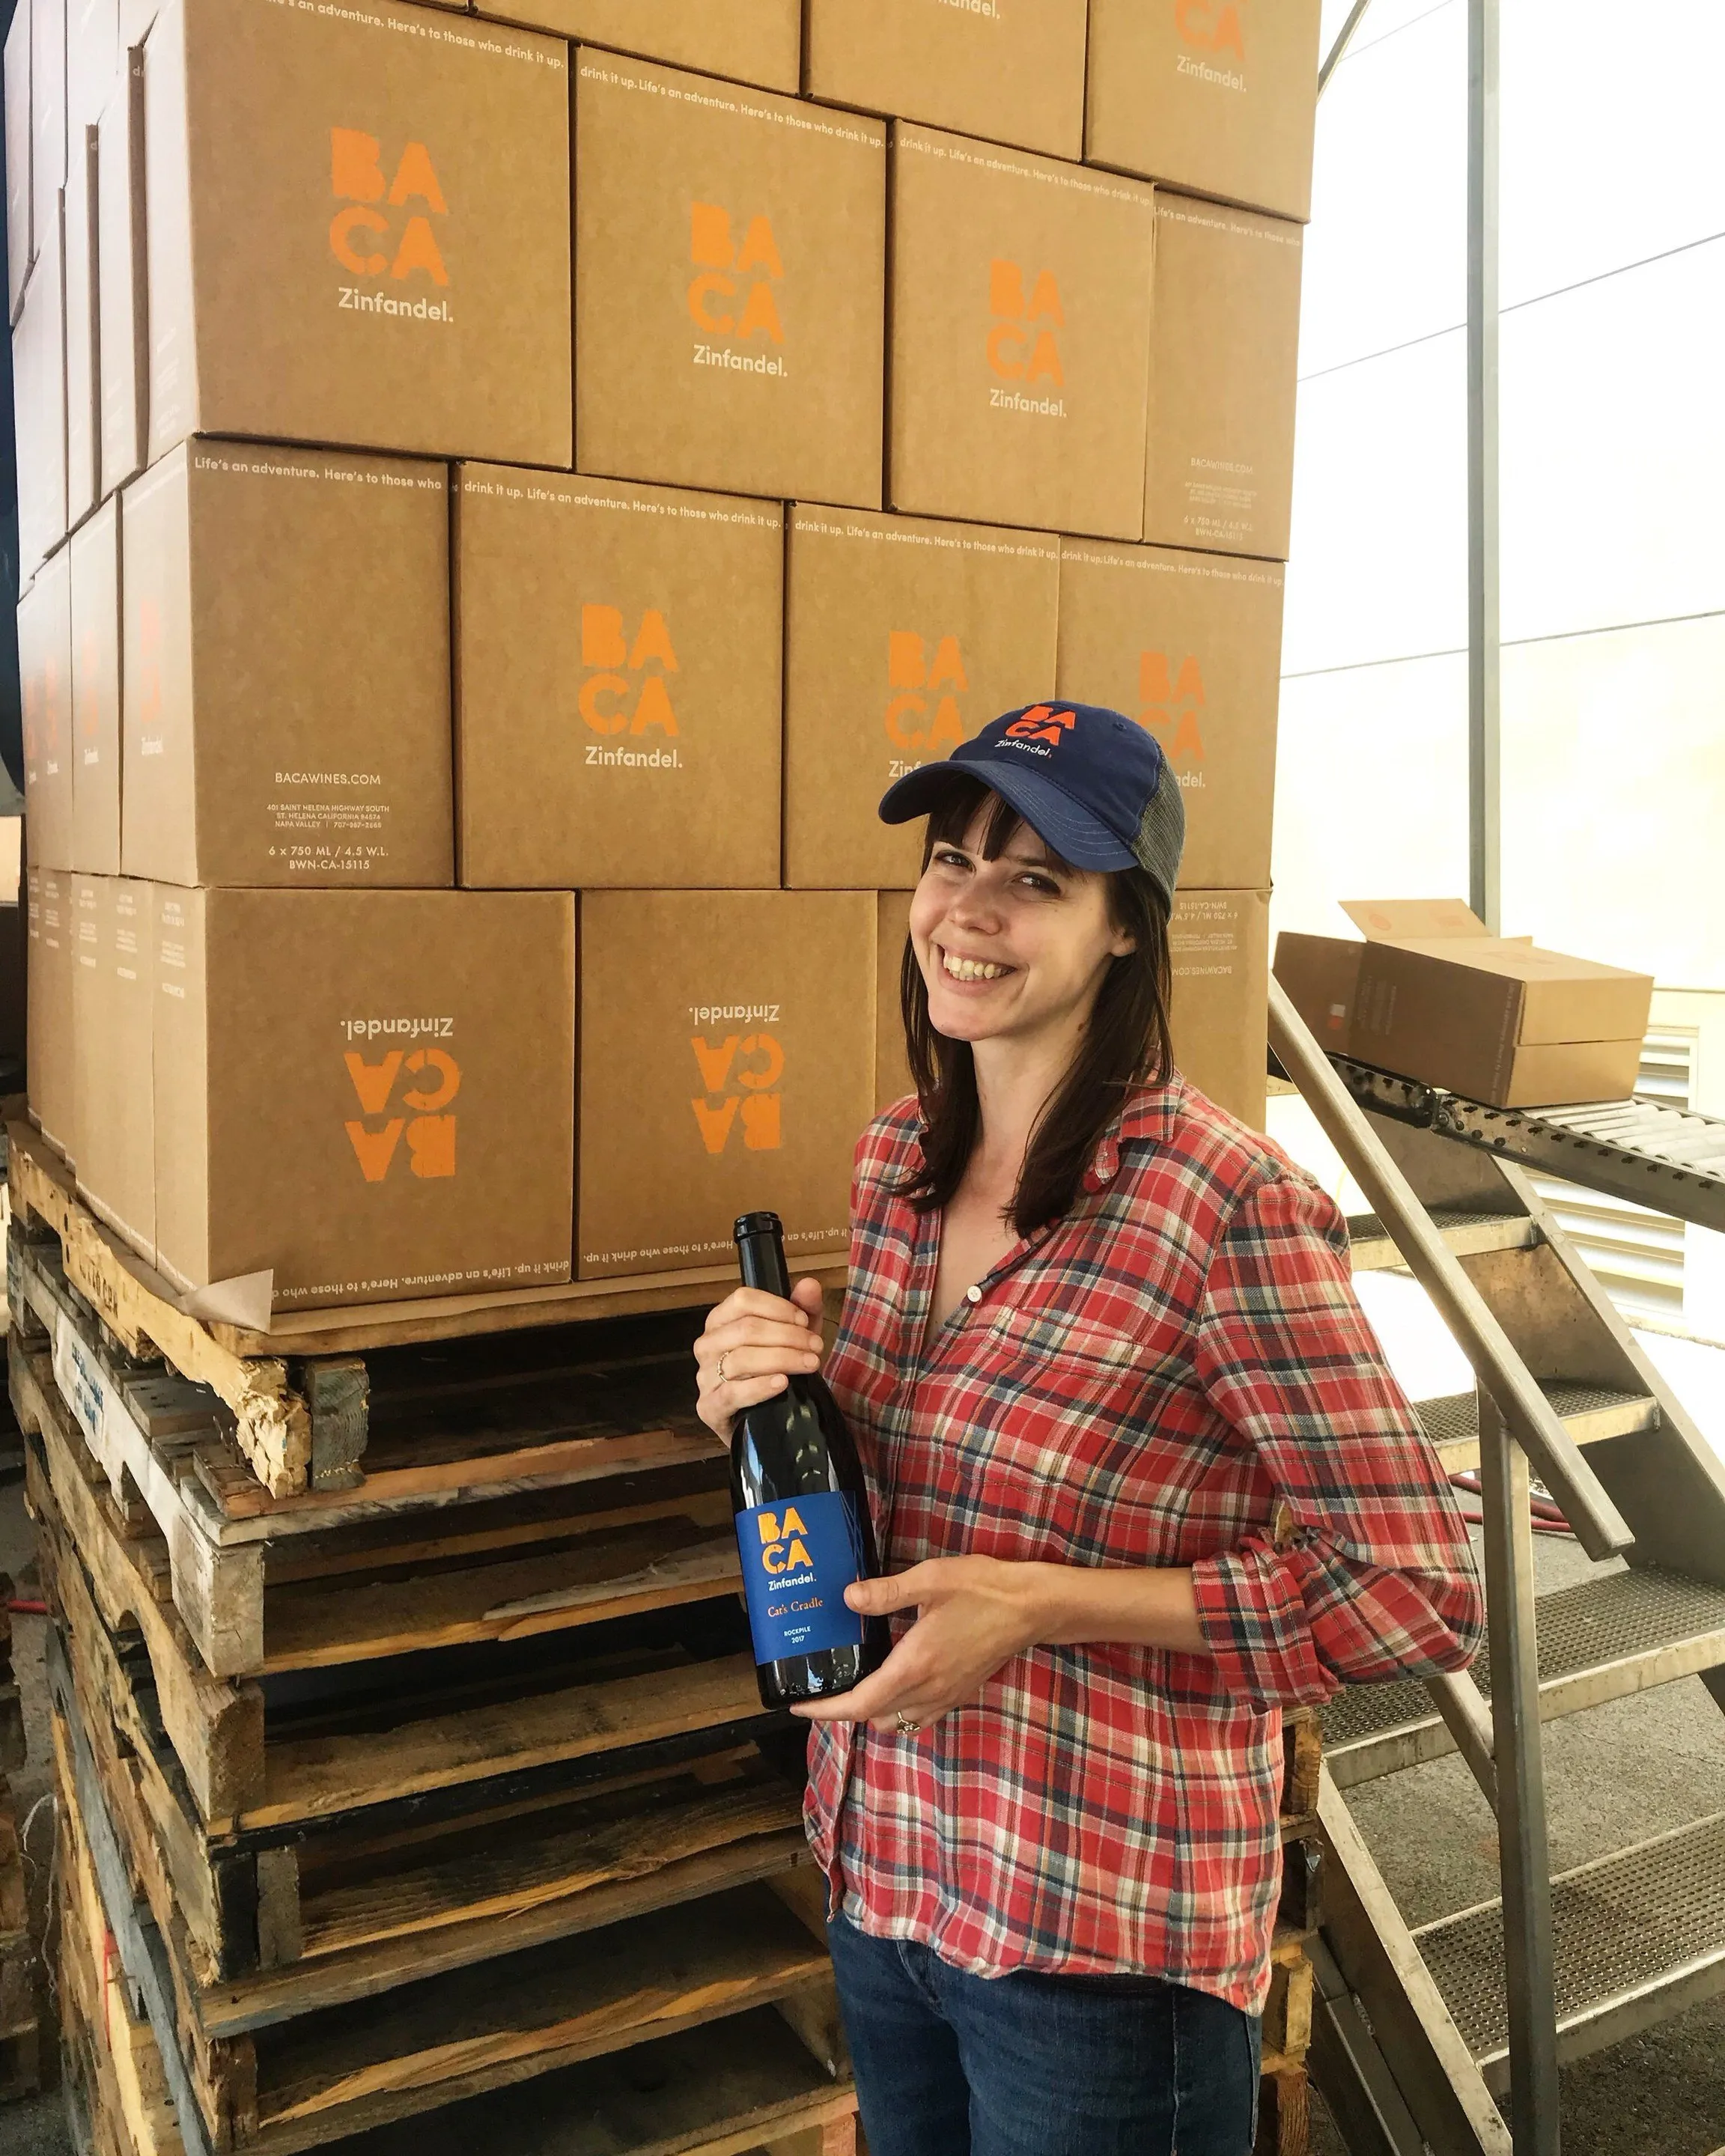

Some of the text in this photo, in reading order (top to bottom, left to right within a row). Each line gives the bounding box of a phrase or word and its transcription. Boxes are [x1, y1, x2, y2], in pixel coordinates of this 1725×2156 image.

[297, 0, 314, 12] an
[317, 3, 384, 27] adventure.
[387, 17, 426, 37] Here's
[428, 27, 441, 40] to
[442, 30, 475, 47] those
[478, 39, 502, 53] who
[505, 44, 534, 61] drink
[536, 50, 544, 63] it
[546, 56, 564, 70] up.
[1176, 54, 1247, 93] Zinfandel.
[579, 65, 884, 148] drink it up. Life's an adventure. Here's to those who drink it up.
[331, 127, 448, 215] BA
[899, 136, 1110, 196] drink it up. Life's an adventure. Here's to those who
[329, 205, 449, 287] CA
[690, 201, 785, 279] BA
[338, 287, 454, 323] Zinfandel.
[989, 258, 1065, 329] BA
[687, 272, 785, 344] CA
[693, 344, 788, 378] Zinfandel.
[987, 323, 1065, 387] CA
[989, 388, 1068, 418] Zinfandel.
[195, 456, 442, 490] Life's an adventure. Here's to those who
[464, 480, 781, 530] drink it up. Life's an adventure. Here's to those who drink it up.
[794, 519, 1058, 561] drink it up. Life's an adventure. Here's to those who drink it up.
[582, 604, 679, 672] BA
[889, 630, 969, 692] BA
[1140, 651, 1205, 706] BA
[579, 673, 679, 737] CA
[1020, 704, 1076, 731] BA
[884, 692, 966, 750] CA
[1005, 720, 1061, 746] CA
[585, 745, 683, 770] Zinfandel.
[994, 739, 1052, 759] Zinfandel.
[275, 772, 381, 785] BACAWINES.COM
[280, 803, 301, 811] SAINT
[302, 804, 329, 812] HELENA
[331, 804, 365, 813] HIGHWAY
[365, 805, 389, 813] SOUTH
[296, 820, 320, 829] VALLEY
[268, 846, 276, 856] 6
[290, 846, 311, 856] 750
[315, 846, 332, 856] ML
[344, 846, 362, 856] 4.5
[365, 846, 389, 856] W.L.
[289, 859, 371, 870] BWN-CA-15115
[690, 1004, 779, 1026] Zinfandel.
[340, 1017, 454, 1041] Zinfandel.
[691, 1032, 785, 1091] CA
[344, 1048, 462, 1114] CA
[692, 1093, 780, 1154] BA
[345, 1115, 456, 1181] BA
[800, 1230, 824, 1241] Life's
[824, 1226, 839, 1237] up.
[840, 1228, 848, 1237] it
[582, 1240, 733, 1263] Here's to those who drink it up.
[401, 1271, 463, 1285] adventure.
[466, 1270, 480, 1279] an
[482, 1267, 511, 1279] Life's
[514, 1262, 531, 1273] up.
[533, 1263, 541, 1274] it
[543, 1260, 569, 1273] drink
[282, 1287, 308, 1299] who
[310, 1282, 344, 1295] those
[346, 1282, 359, 1292] to
[361, 1278, 398, 1291] Here's
[758, 1506, 808, 1544] BA
[762, 1538, 814, 1575] CA
[768, 1572, 817, 1592] Zinfandel.
[767, 1597, 824, 1618] Cat's Cradle
[783, 1625, 812, 1637] ROCKPILE
[791, 1634, 805, 1644] 2017
